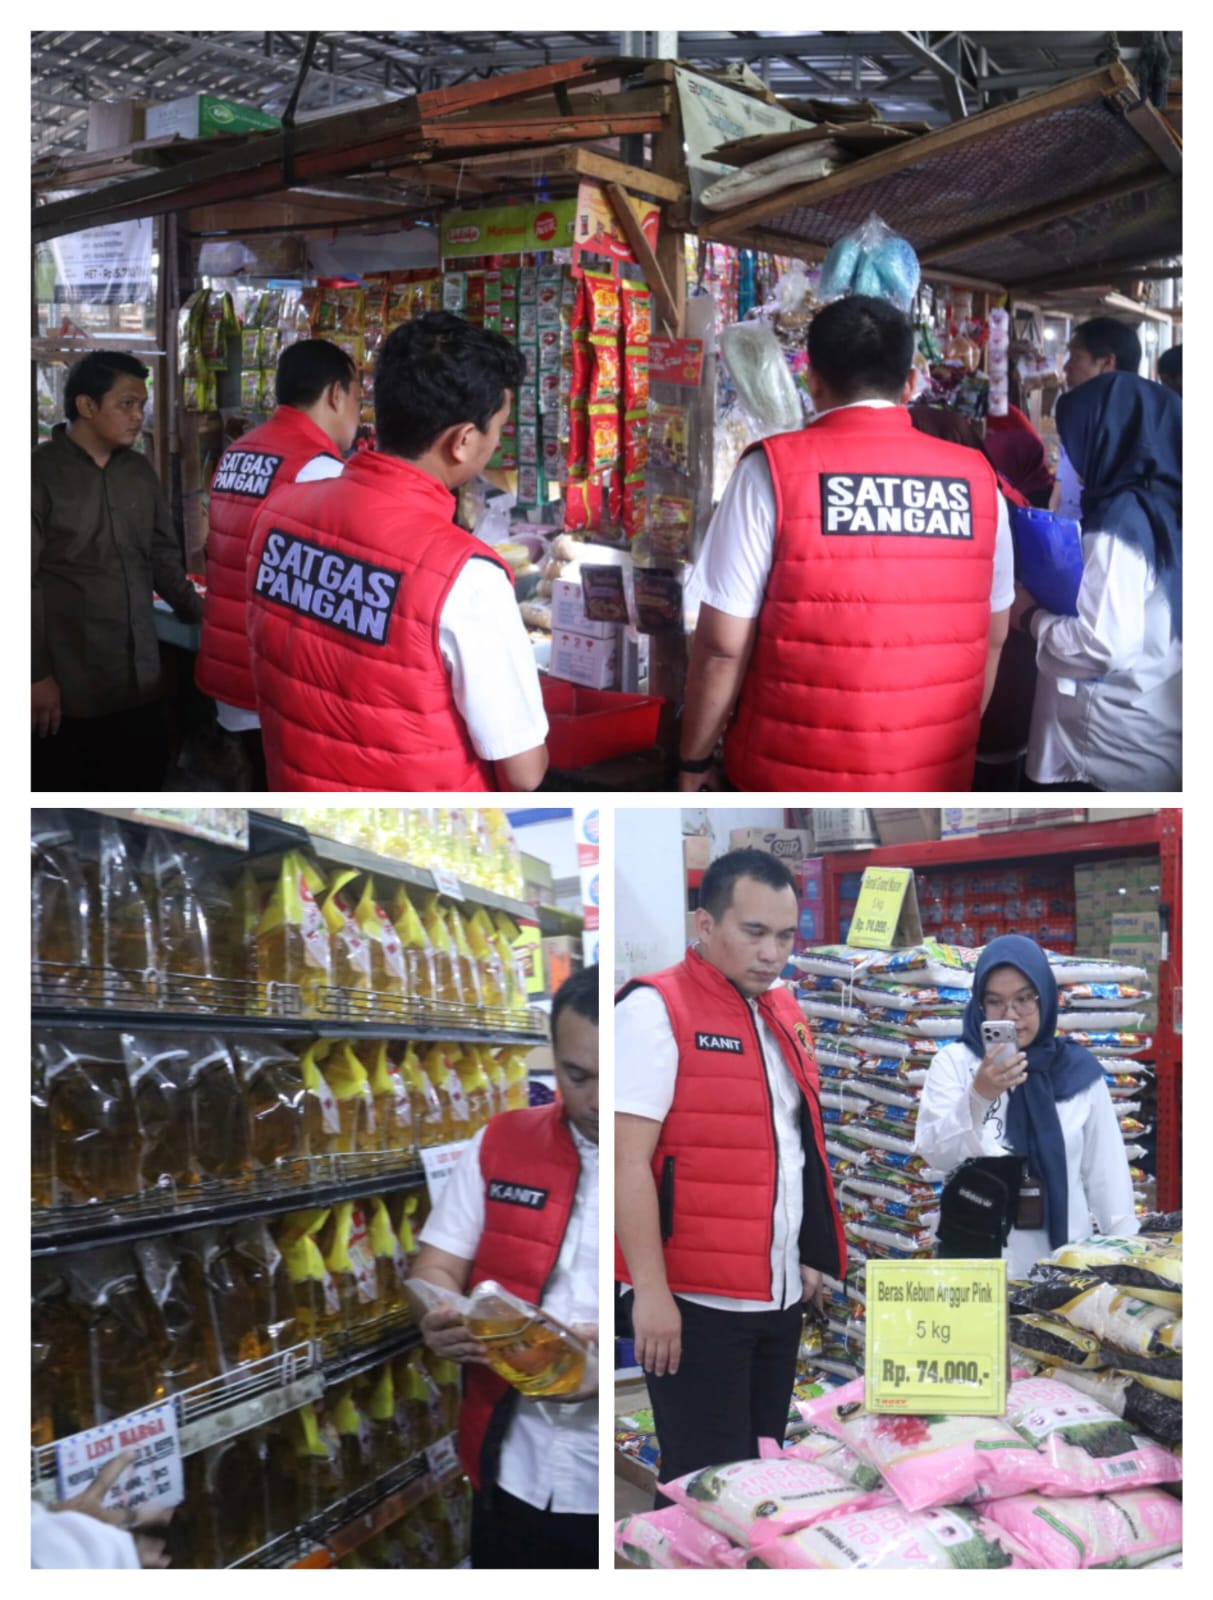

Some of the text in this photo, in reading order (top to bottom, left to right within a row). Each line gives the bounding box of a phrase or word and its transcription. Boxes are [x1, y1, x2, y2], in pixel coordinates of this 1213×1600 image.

[220, 453, 278, 476] SATGAS
[213, 470, 270, 495] PANGAN
[827, 476, 970, 511] SATGAS
[827, 506, 971, 536] PANGAN
[263, 534, 396, 609] SATGAS
[255, 564, 388, 641] PANGAN
[698, 1034, 741, 1050] KANIT
[489, 1182, 545, 1205] KANIT
[878, 1281, 993, 1308] Beras Kebun Anggur Pink
[916, 1320, 951, 1344] 5 kg
[882, 1359, 989, 1388] Rp. 74.000,-
[86, 1435, 114, 1460] LIST
